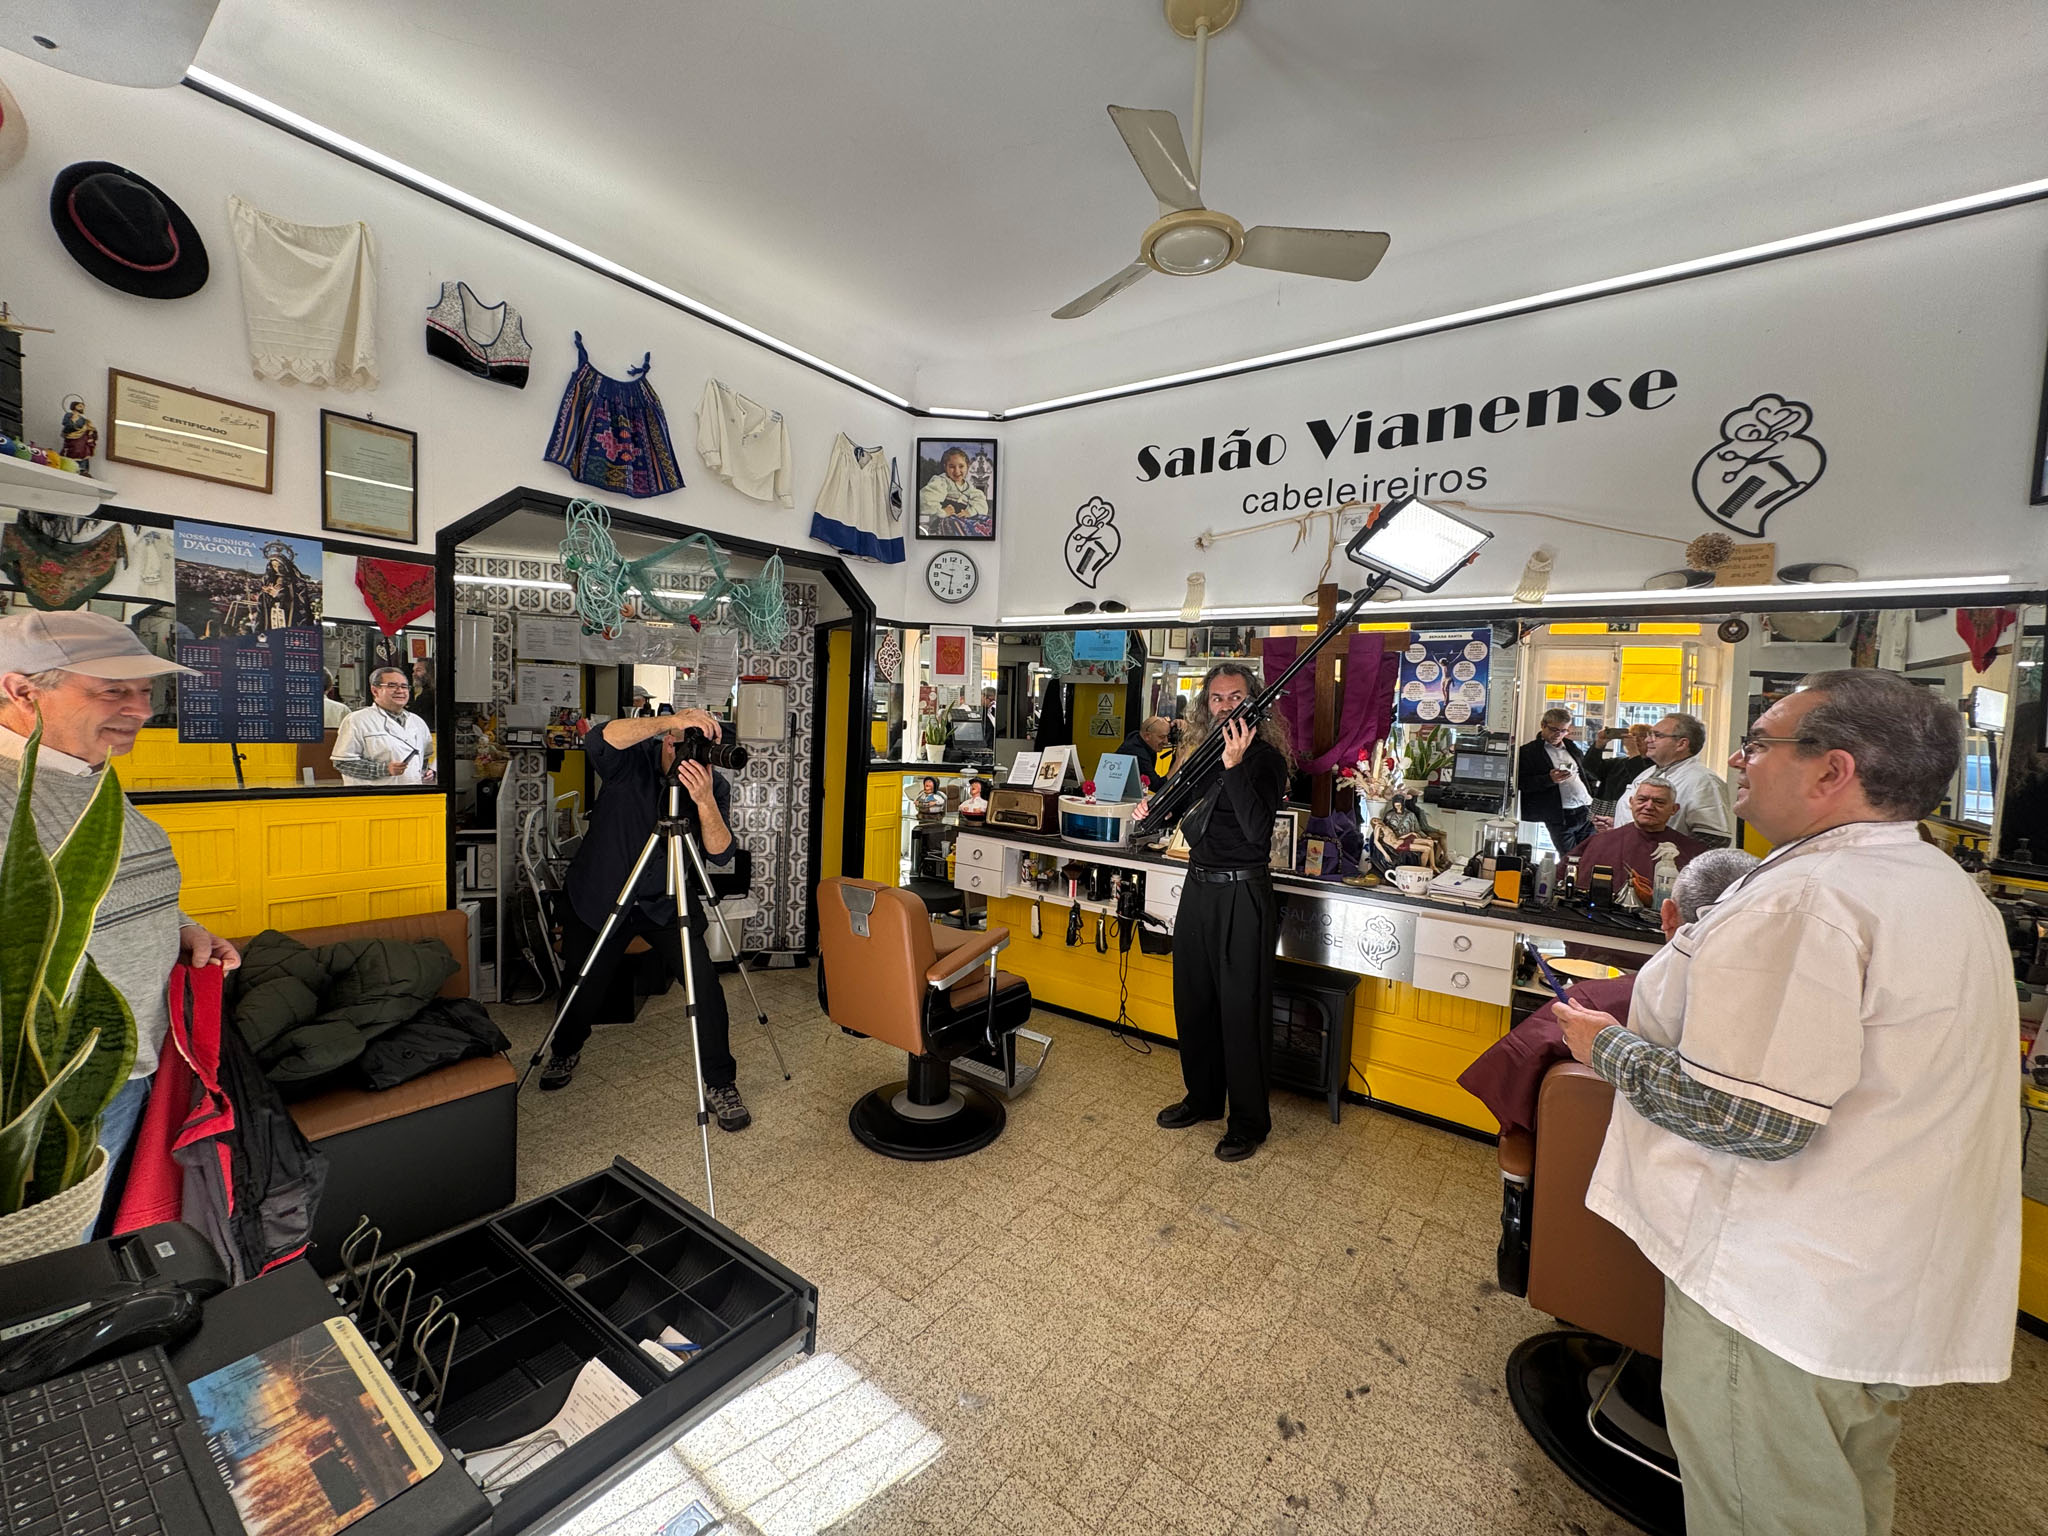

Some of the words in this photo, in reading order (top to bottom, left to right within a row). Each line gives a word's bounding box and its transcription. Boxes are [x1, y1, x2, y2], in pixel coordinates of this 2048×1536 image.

[162, 415, 228, 436] CERTIFICADO
[1136, 427, 1287, 482] Salão
[1306, 369, 1678, 460] Vianense
[1242, 466, 1488, 514] cabeleireiros
[179, 532, 210, 542] NOSSA
[212, 536, 257, 549] SENHORA
